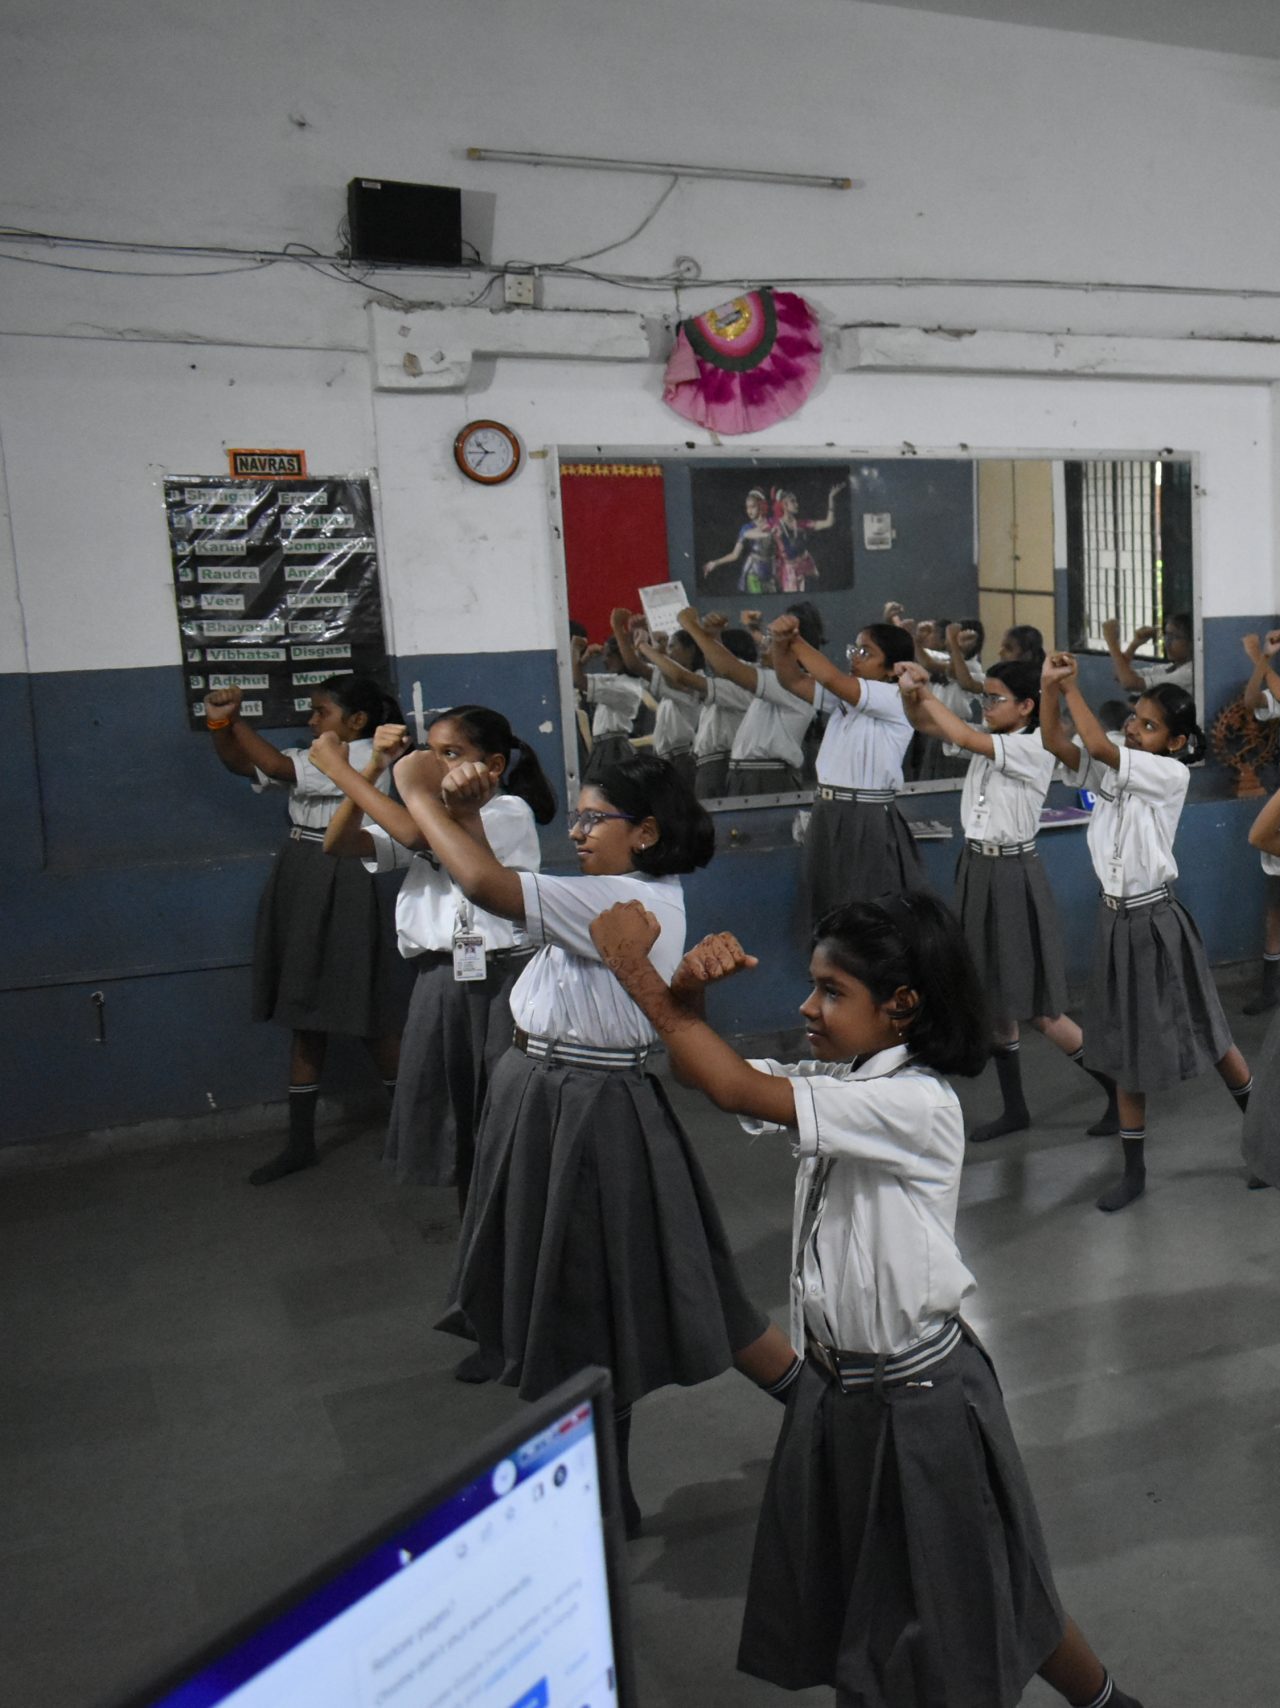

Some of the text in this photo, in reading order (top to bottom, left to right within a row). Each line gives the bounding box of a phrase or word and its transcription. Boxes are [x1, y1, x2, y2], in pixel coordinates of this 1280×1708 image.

[239, 457, 295, 472] NAVRAS
[285, 540, 374, 552] Compason
[201, 568, 258, 580] Raudra
[203, 595, 241, 606] Veer
[290, 594, 347, 606] Bavery
[210, 649, 280, 660] Vibhatsa
[211, 674, 268, 686] Adbhut
